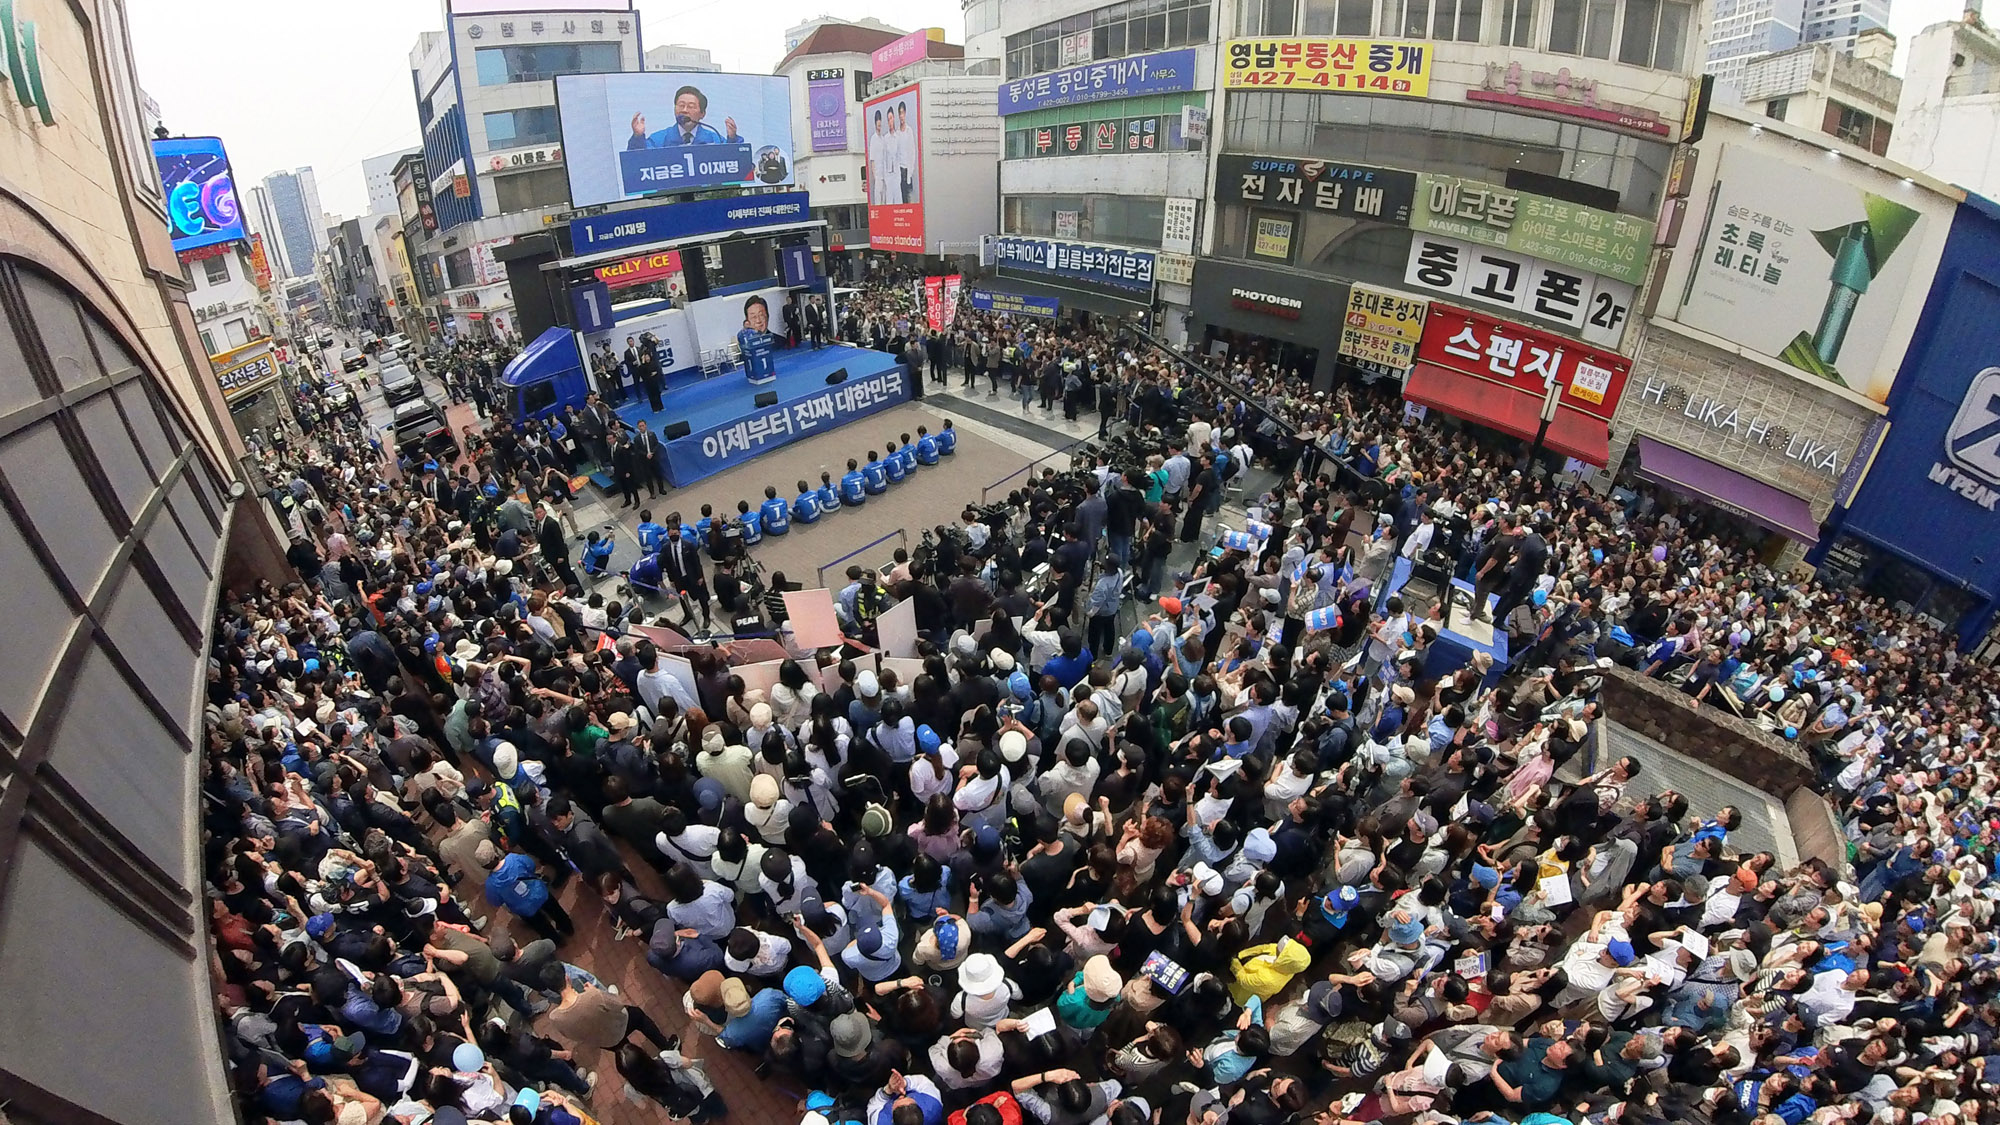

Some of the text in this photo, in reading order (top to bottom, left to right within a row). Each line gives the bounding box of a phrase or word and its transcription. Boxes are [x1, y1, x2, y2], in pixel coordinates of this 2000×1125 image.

[1064, 34, 1089, 53] 임대
[1230, 43, 1424, 75] 영남부동산 중개
[810, 68, 843, 80] 2:19:27
[1009, 58, 1177, 103] 동성로 공인중개사 사무소
[1244, 71, 1390, 90] 427-4114
[1076, 88, 1129, 102] 010-6799-3456
[1037, 122, 1117, 153] 부동산
[1129, 119, 1156, 134] 매매
[1188, 122, 1206, 134] 부동산
[1129, 135, 1154, 150] 임대
[640, 153, 739, 181] 지금은 1 이재명
[1252, 160, 1296, 174] SUPER
[1329, 167, 1375, 183] VAPE
[1241, 174, 1384, 216] 전자담배
[1429, 181, 1518, 229] 에코폰
[727, 203, 801, 220] 이제부터 진짜 대한민국
[1526, 200, 1569, 223] 중고폰
[1727, 204, 1795, 237] 숨은 주름 잡는
[585, 225, 594, 243] 1
[613, 221, 647, 238] 이재명
[1258, 221, 1290, 238] 임대문의
[1427, 219, 1469, 236] NAVER
[1720, 223, 1766, 254] 초.록
[894, 234, 922, 247] standard
[1522, 220, 1636, 261] 아이폰 스마트폰 A/S
[601, 254, 670, 278] KELLY ICE
[793, 251, 806, 281] 1
[997, 242, 1044, 264] 머쓱케이스
[1058, 247, 1152, 282] 필름부착전문점
[1713, 245, 1782, 286] 레.티.놀
[1417, 241, 1583, 321] 중고폰
[1590, 292, 1626, 330] 2F
[583, 290, 602, 327] 1
[1232, 288, 1302, 309] PHOTOISM
[1350, 290, 1426, 326] 휴대폰성지
[1348, 312, 1366, 327] 4F
[1344, 329, 1411, 357] 영남부동산 중개
[761, 357, 767, 369] 1
[1444, 326, 1563, 389] 스펀지
[219, 357, 272, 390] 착전문점
[1579, 375, 1603, 390] 전문점
[1580, 365, 1609, 382] 필름부착
[702, 371, 903, 458] 이제부터 진짜 대한민국
[1641, 376, 1838, 475] HOLIKA HOLIKA
[1836, 418, 1880, 500] HOLIKA HOLIKA
[876, 468, 882, 481] 1
[855, 481, 861, 493] 1
[773, 507, 781, 520] 1
[809, 499, 816, 511] 1
[642, 532, 647, 545] 1
[746, 523, 755, 537] 1
[736, 615, 759, 627] PEAK
